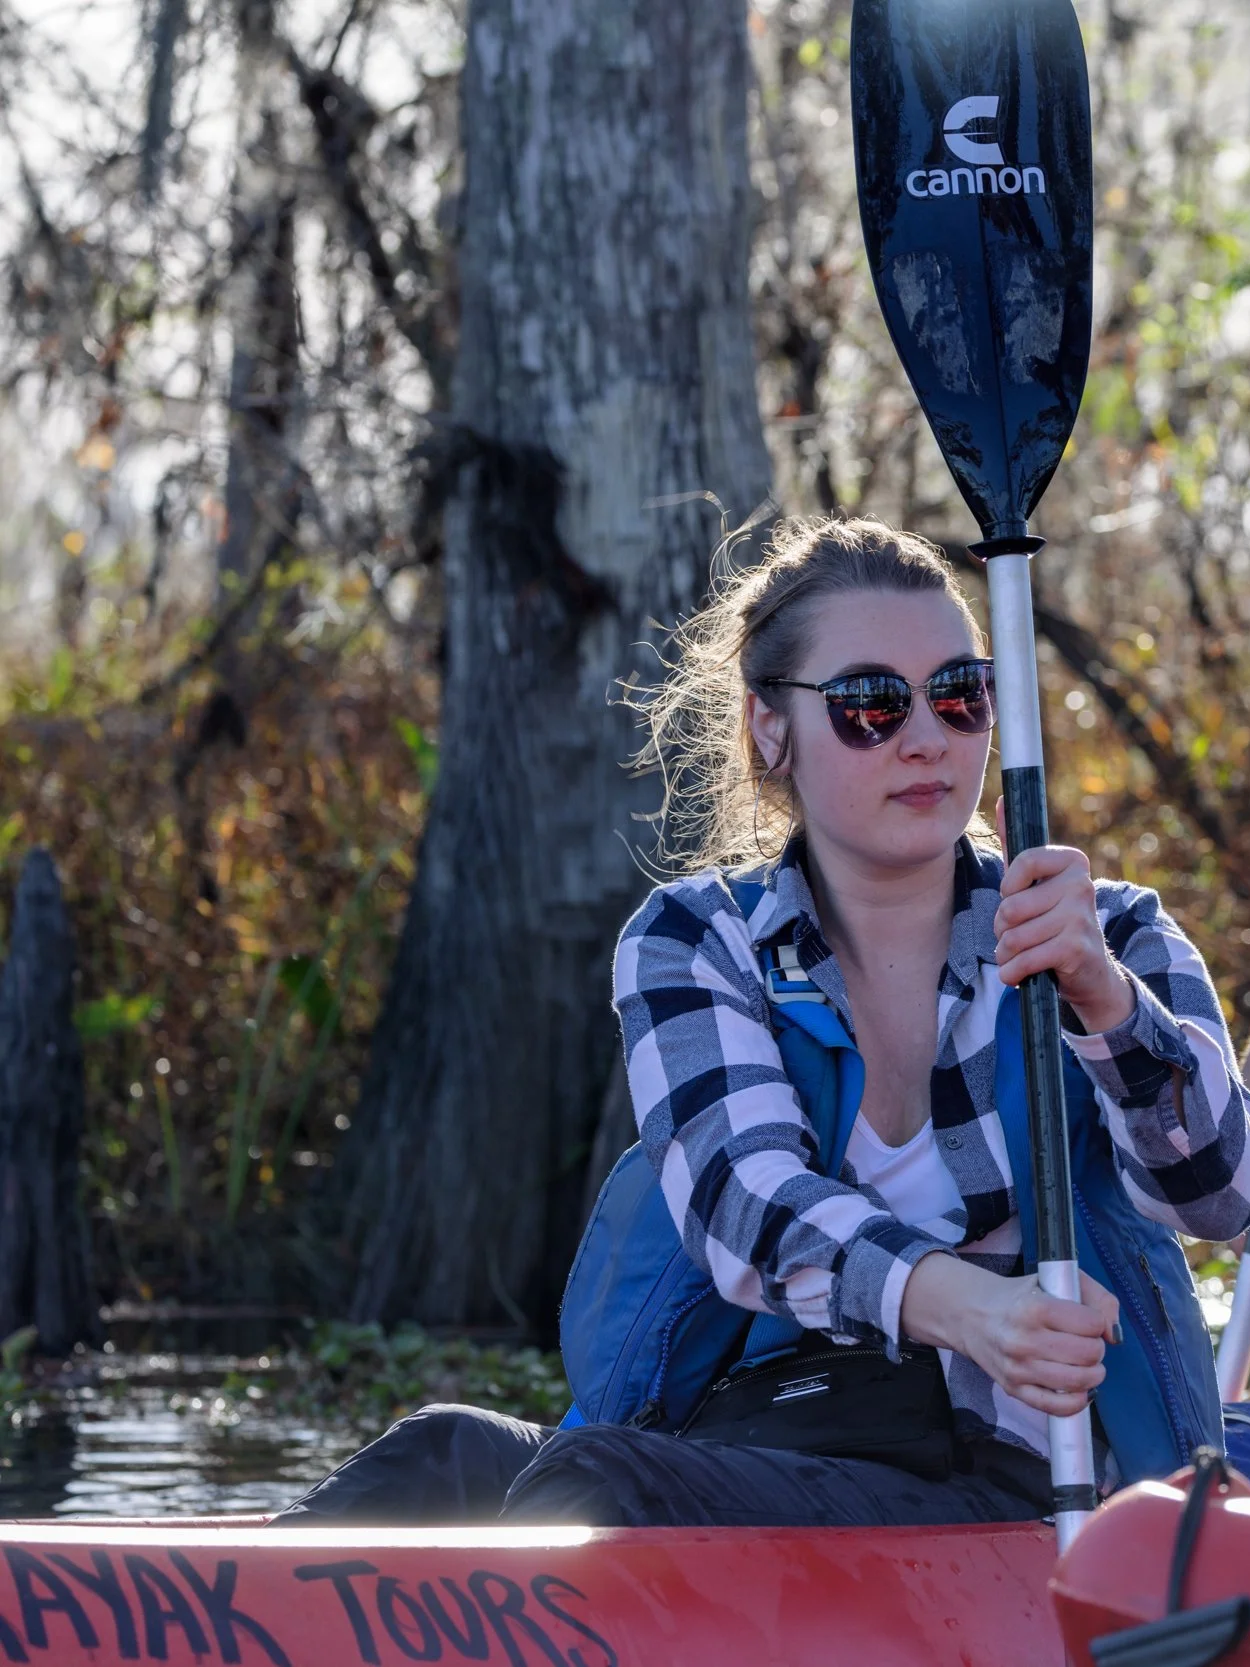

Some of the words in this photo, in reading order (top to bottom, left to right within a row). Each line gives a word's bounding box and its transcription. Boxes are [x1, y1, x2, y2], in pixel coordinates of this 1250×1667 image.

[906, 166, 1046, 198] cannon
[0, 1546, 292, 1667] AYAK
[293, 1560, 618, 1667] TOURS
